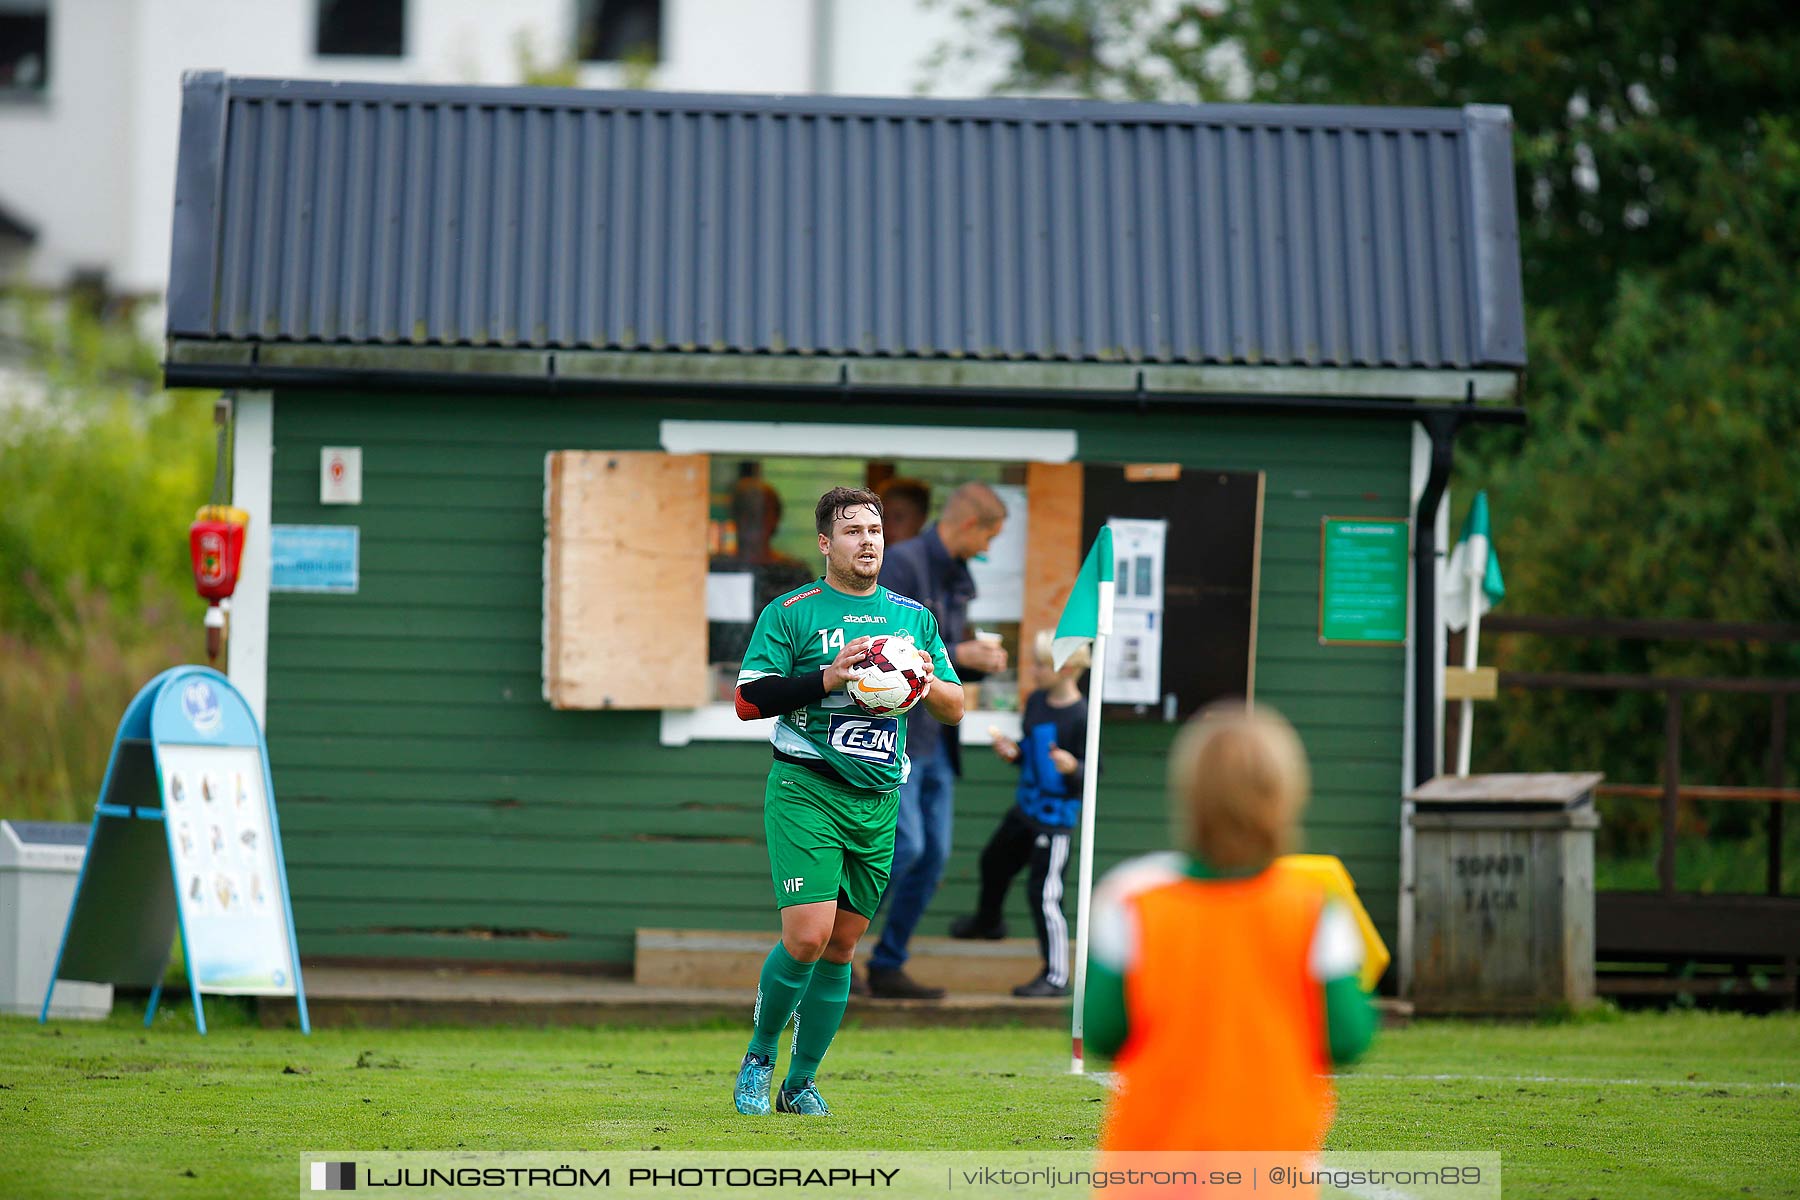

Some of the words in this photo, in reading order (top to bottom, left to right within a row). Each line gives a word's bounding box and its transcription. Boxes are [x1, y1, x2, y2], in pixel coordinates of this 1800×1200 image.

[843, 614, 887, 624] stadium
[818, 628, 845, 654] 14
[783, 878, 804, 893] VIF
